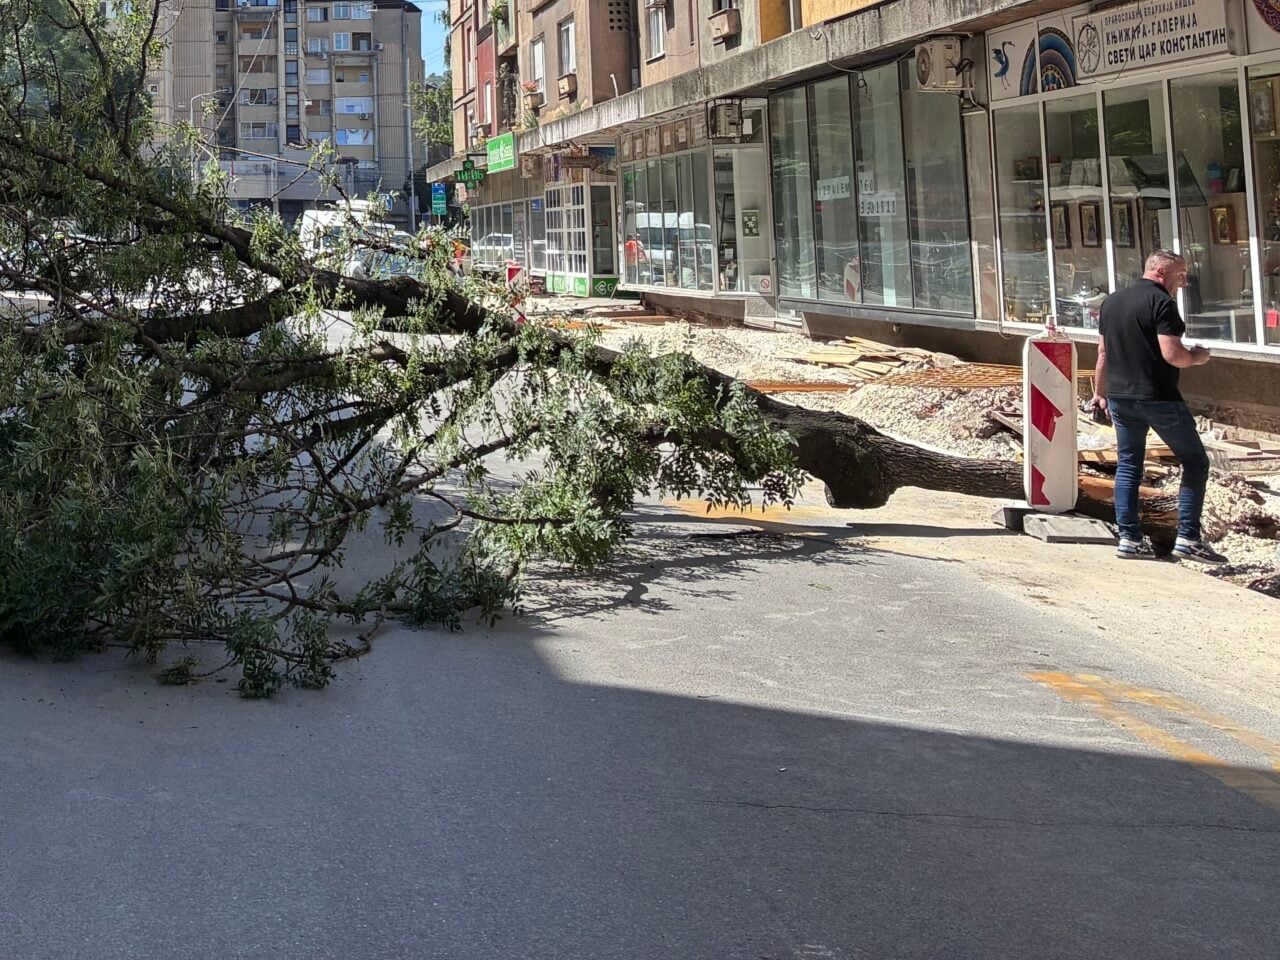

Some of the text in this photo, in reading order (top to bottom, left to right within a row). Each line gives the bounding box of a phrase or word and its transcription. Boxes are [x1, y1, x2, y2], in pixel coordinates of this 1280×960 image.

[1143, 1, 1174, 18] ЕПАРХИЈА
[1105, 12, 1198, 45] КЊИЖАРА-ГАЛЕРИЈА
[1107, 27, 1227, 66] СВЕТИ ЦАР КОНСТАНТИН
[456, 170, 484, 181] 10:06
